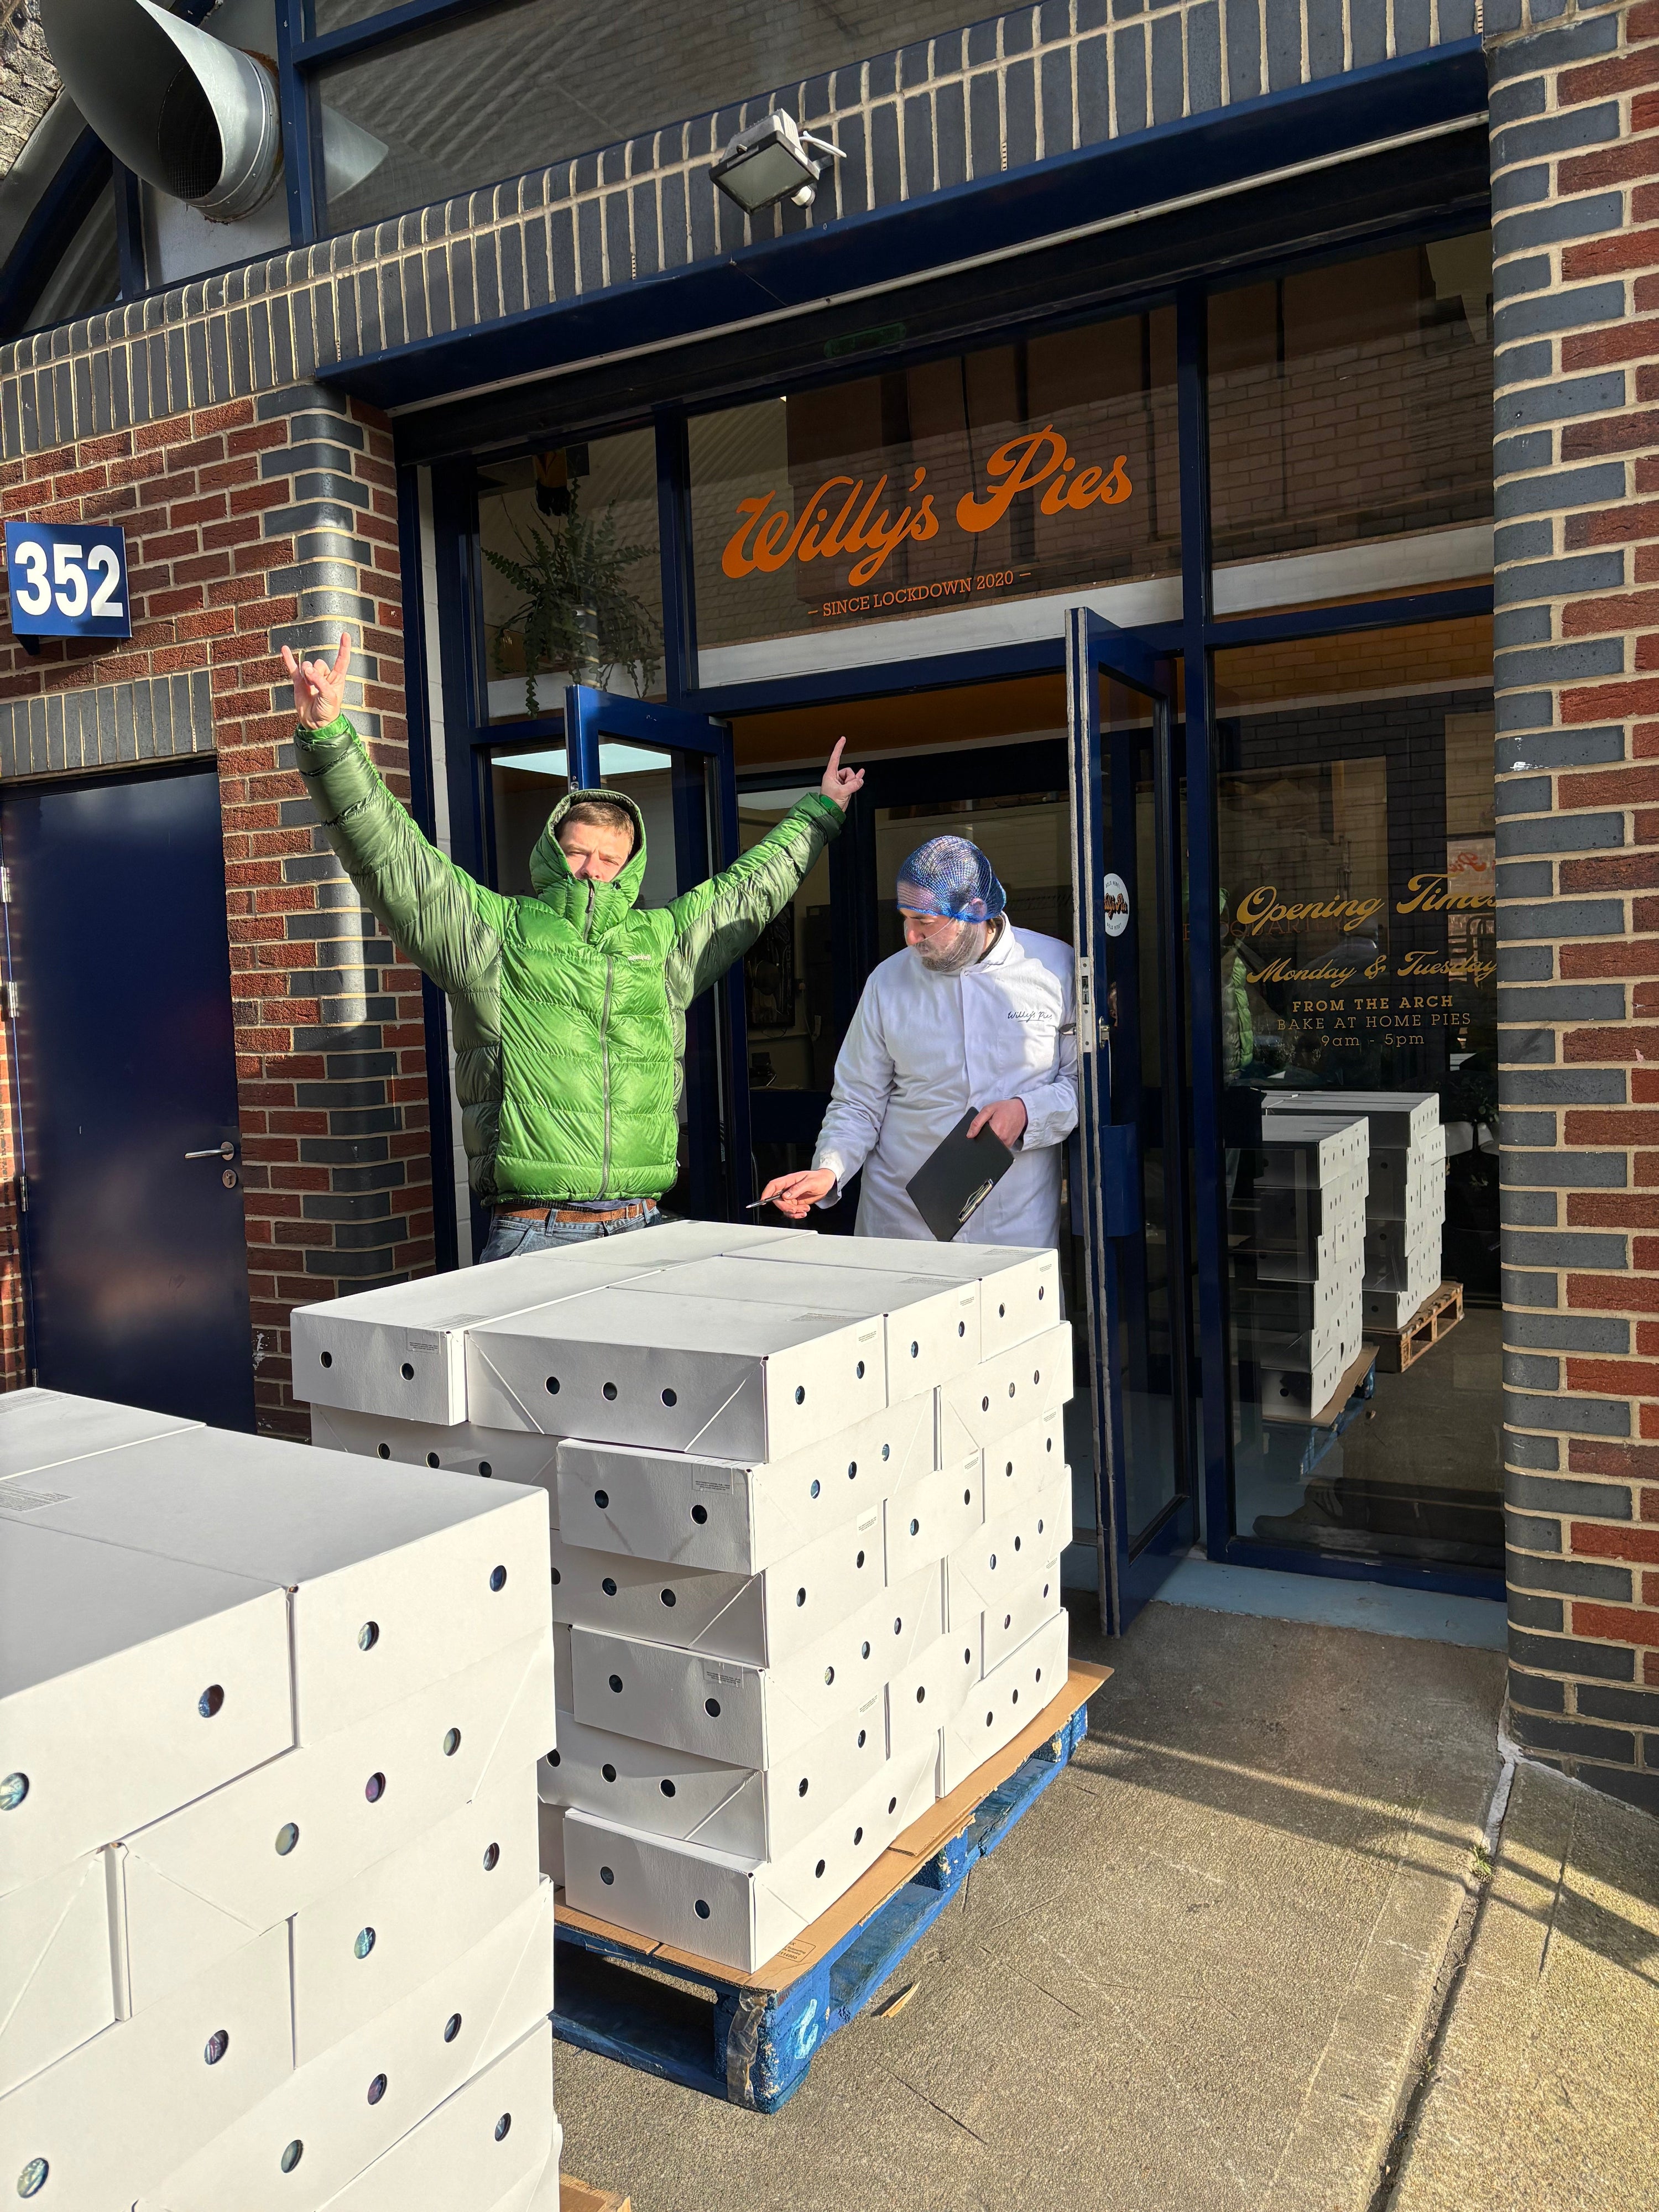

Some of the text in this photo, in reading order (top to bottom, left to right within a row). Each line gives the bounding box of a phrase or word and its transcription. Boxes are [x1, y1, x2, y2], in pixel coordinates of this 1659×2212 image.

[722, 425, 1133, 587] Willy's Pies
[14, 541, 123, 617] 352
[823, 570, 1014, 617] SINCE LOCKDOWN 2020
[1237, 886, 1385, 936] Opening
[1246, 951, 1496, 988] Monday & Tuesday
[1277, 1013, 1471, 1030] BAKE AT HOME PIES
[1292, 995, 1453, 1013] FROM THE ARCH
[1321, 1035, 1360, 1046] 9am
[1385, 1034, 1425, 1047] 5pm
